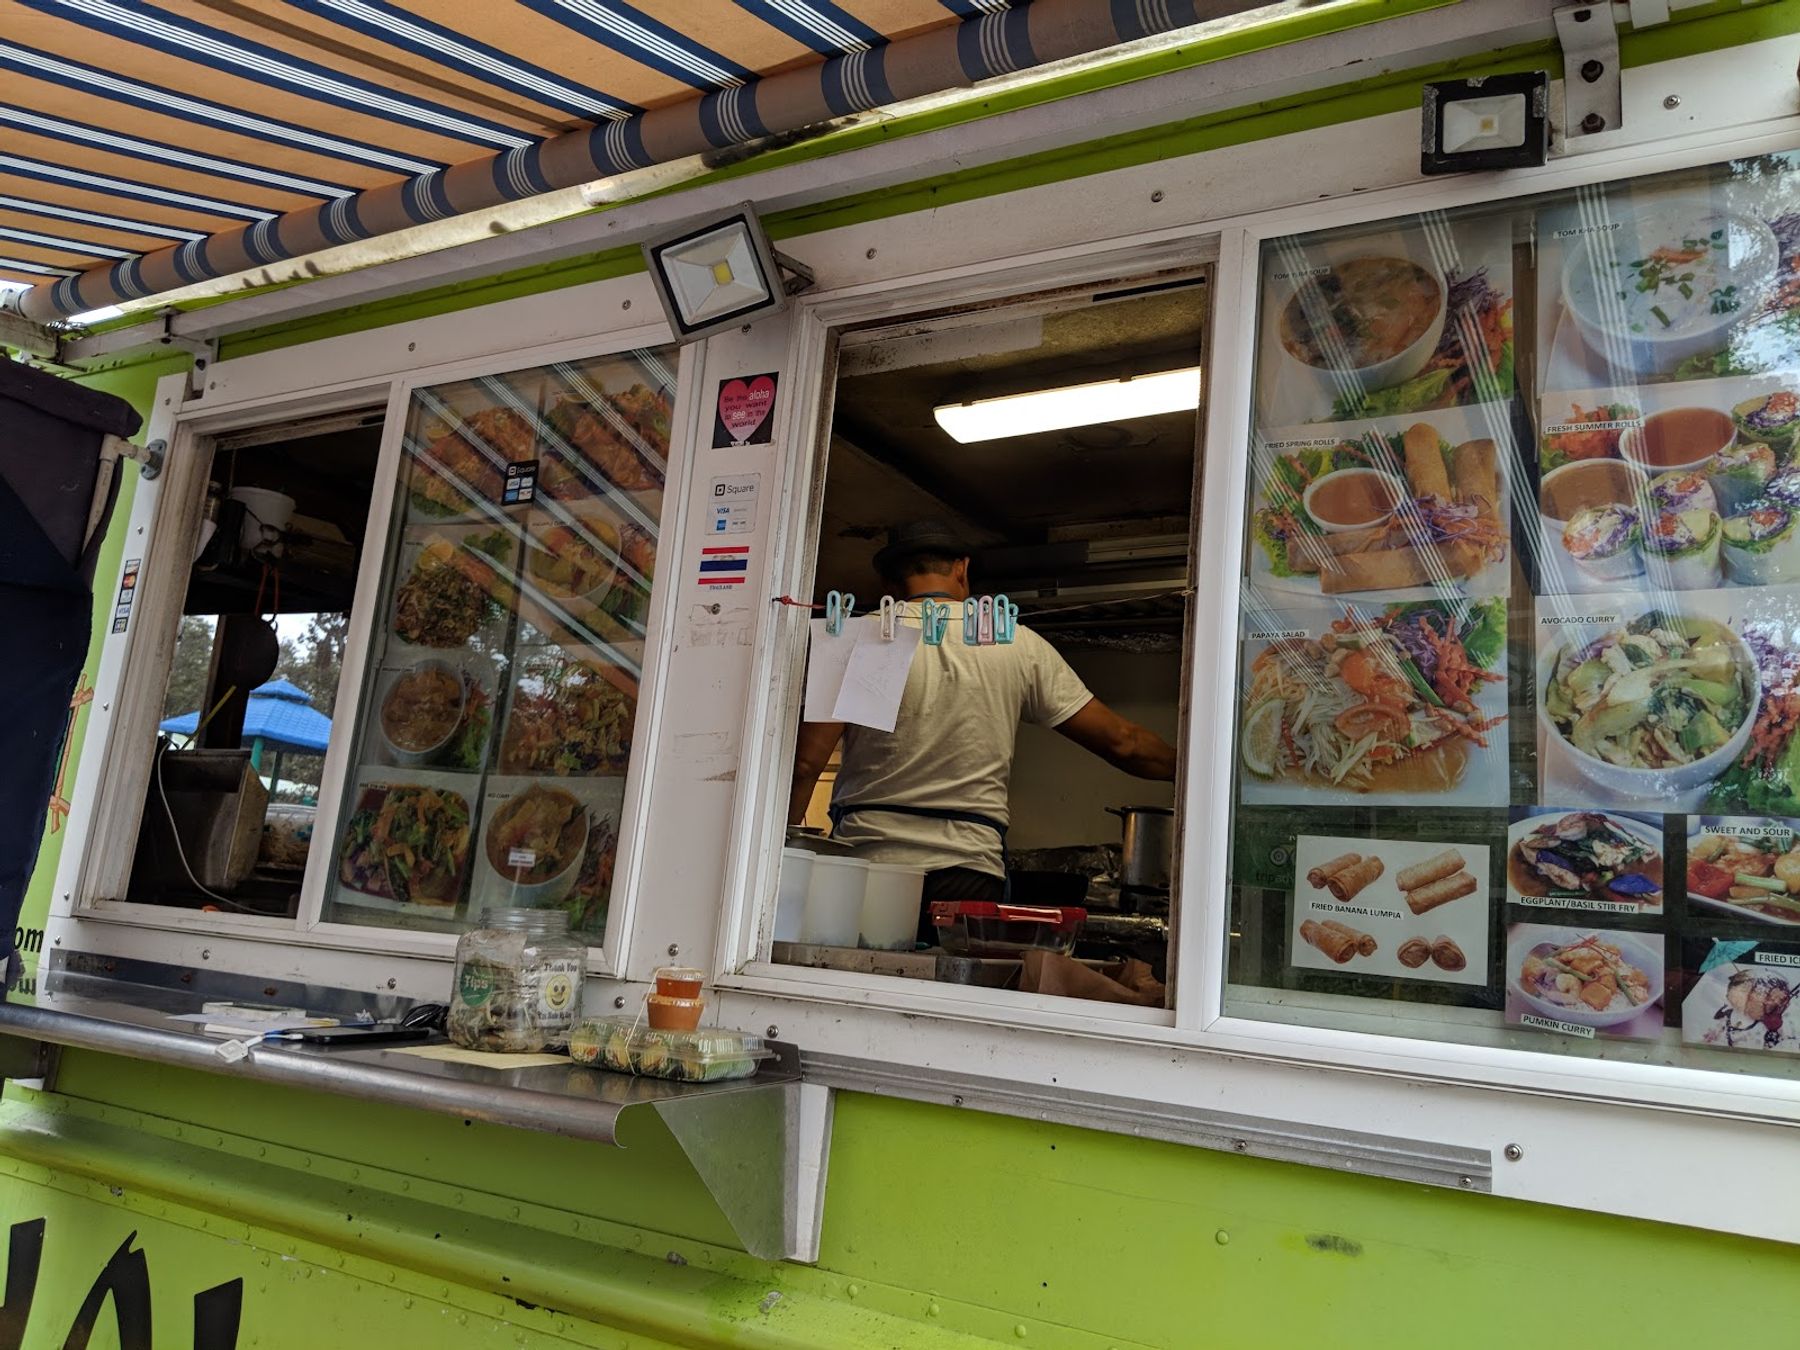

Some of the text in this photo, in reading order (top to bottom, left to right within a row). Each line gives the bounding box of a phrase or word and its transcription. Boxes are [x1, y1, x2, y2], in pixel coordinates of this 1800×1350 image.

[1558, 229, 1577, 238] TOM
[749, 389, 770, 400] aloha
[725, 400, 767, 412] you want
[732, 411, 746, 420] see
[1575, 422, 1614, 431] SUMMER
[1615, 420, 1642, 429] ROLLS
[1265, 438, 1335, 449] FRIED SPRING ROLLS
[726, 484, 755, 495] Square
[1541, 615, 1616, 625] AVOCADO CURRY
[1705, 825, 1790, 837] SWEET AND SOUR
[1520, 896, 1636, 913] EGGPLANT/BASIL STIR FRY
[1311, 902, 1401, 919] FRIED BANANA LUMPIA
[1760, 954, 1800, 965] FRIED IC
[465, 975, 489, 991] Tips
[1523, 1015, 1592, 1036] PUMKIN CURRY
